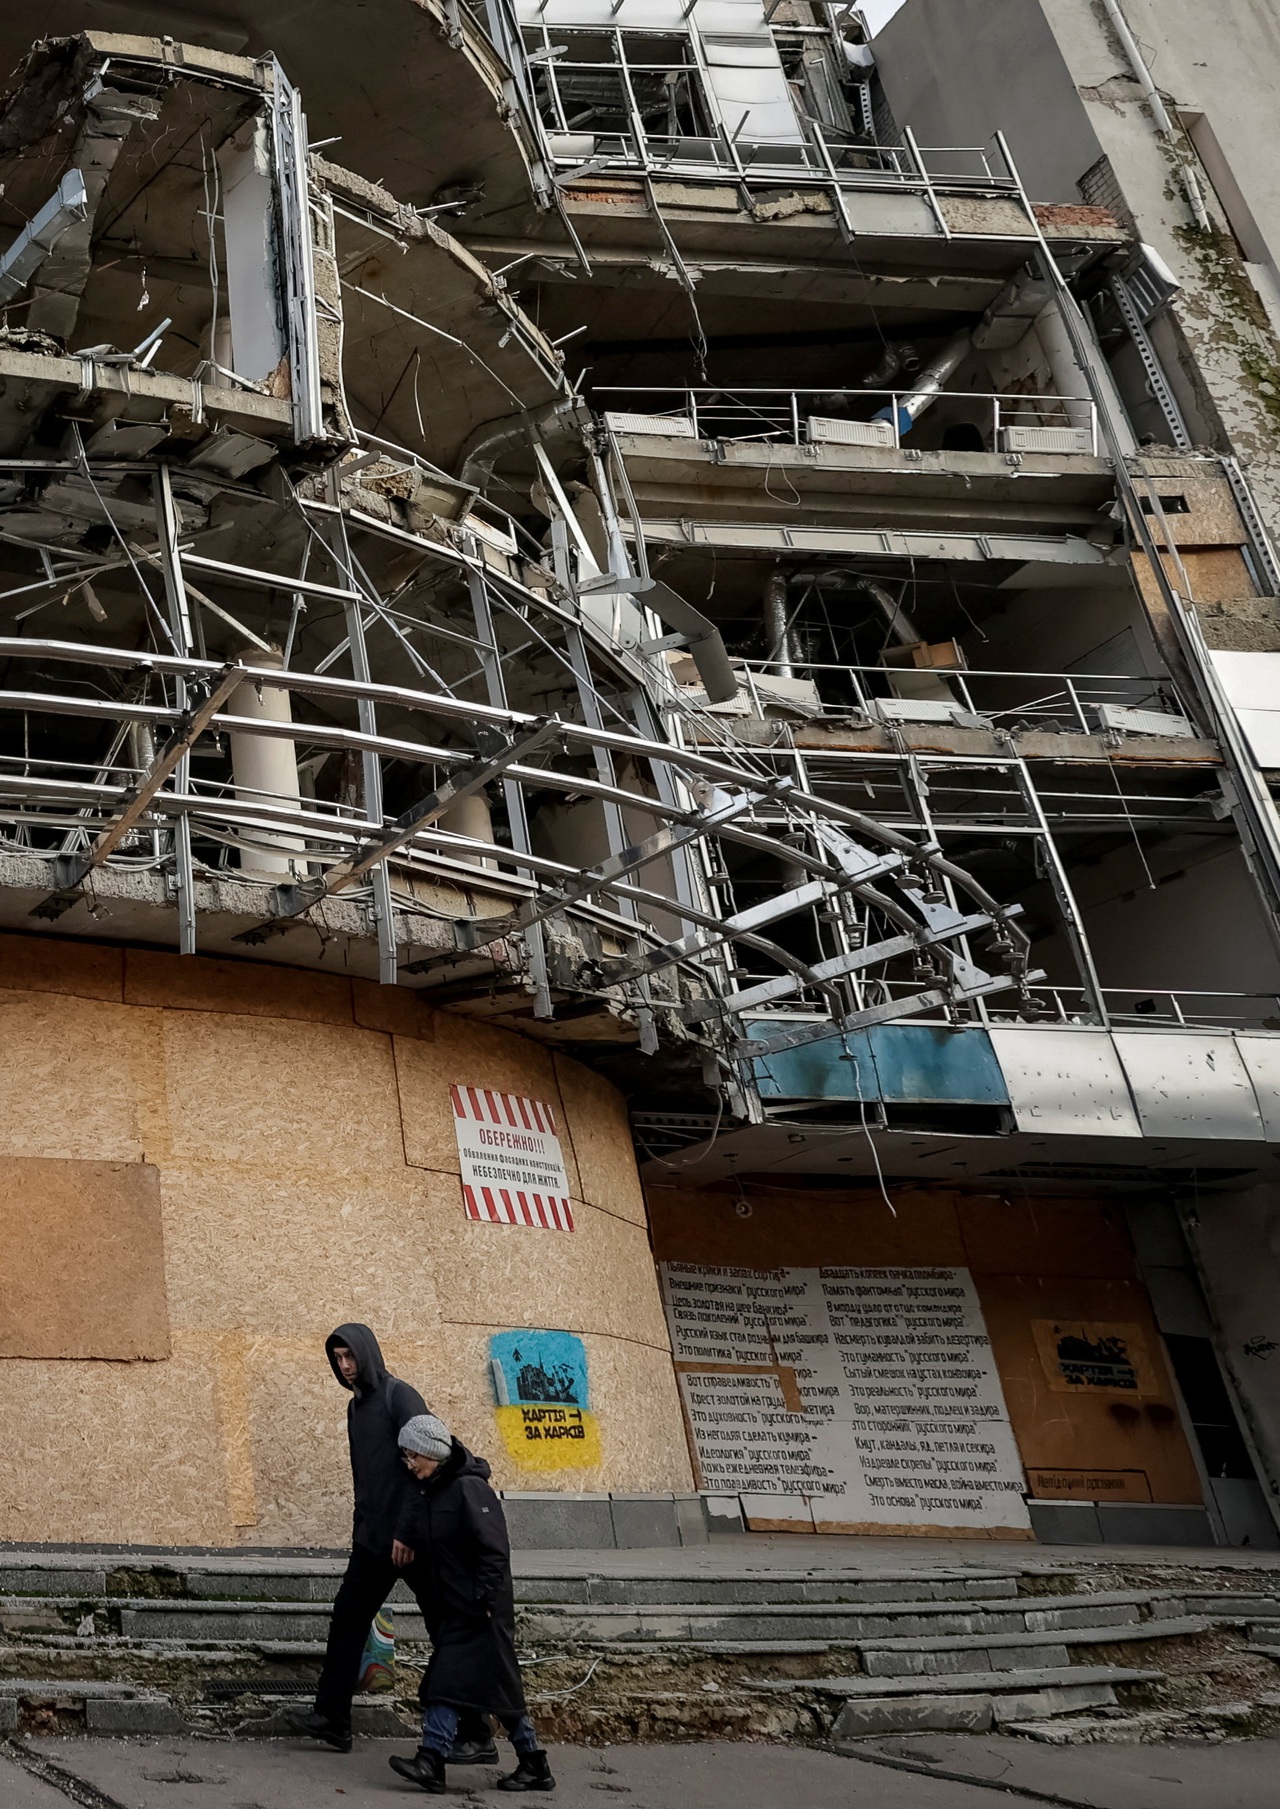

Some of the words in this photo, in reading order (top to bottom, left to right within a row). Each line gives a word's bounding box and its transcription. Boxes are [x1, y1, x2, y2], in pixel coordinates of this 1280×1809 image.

[479, 1128, 545, 1154] ОБЕРЕЖНО!!!
[463, 1148, 498, 1162] Обвалення
[499, 1153, 529, 1167] фасадних
[472, 1164, 521, 1182] НЕБЕЗПЕЧНО
[522, 1171, 537, 1185] ДЛЯ
[537, 1174, 561, 1189] ЖИТТЯ.
[669, 1278, 704, 1291] Внешние
[704, 1282, 742, 1295] признаки
[822, 1284, 854, 1296] Память
[673, 1308, 697, 1320] Связь
[697, 1312, 740, 1324] поколений
[829, 1315, 845, 1327] Вот
[675, 1325, 709, 1340] Русский
[709, 1330, 728, 1341] язык
[729, 1332, 747, 1342] стал
[833, 1332, 876, 1347] Насмерть
[915, 1332, 945, 1345] забить
[678, 1342, 693, 1355] Это
[693, 1346, 732, 1359] политика
[839, 1350, 855, 1362] Это
[855, 1352, 905, 1365] гуманность
[686, 1374, 701, 1387] Вот
[702, 1377, 770, 1389] справедливость
[843, 1366, 872, 1378] Сытый
[873, 1369, 906, 1378] смешок
[906, 1369, 917, 1378] на
[917, 1369, 942, 1382] устах
[690, 1392, 715, 1406] Крест
[716, 1392, 751, 1406] золотой
[751, 1396, 761, 1406] на
[848, 1384, 865, 1396] Это
[865, 1387, 914, 1399] реальность
[521, 1408, 566, 1423] ХАРТІЯ
[690, 1409, 707, 1422] Это
[708, 1411, 758, 1425] духовность
[854, 1402, 874, 1417] Вор,
[524, 1425, 542, 1440] ЗА
[543, 1424, 585, 1440] ХАРКІВ
[694, 1427, 706, 1440] Из
[706, 1430, 742, 1442] негодяя
[742, 1430, 777, 1442] сделать
[867, 1421, 912, 1434] сторонник
[698, 1445, 745, 1459] Идеология
[854, 1436, 880, 1453] Кнут,
[880, 1440, 920, 1452] кандалы,
[934, 1441, 960, 1452] петля
[966, 1442, 996, 1456] секира
[701, 1461, 725, 1473] Ложь
[725, 1463, 780, 1474] ежедневная
[859, 1455, 900, 1470] Издревле
[900, 1459, 932, 1471] скрепы
[703, 1476, 720, 1489] Это
[864, 1474, 894, 1489] Смерть
[894, 1477, 923, 1489] вместо
[923, 1478, 951, 1490] масла,
[950, 1477, 974, 1490] война
[974, 1480, 1003, 1491] вместо
[1003, 1481, 1024, 1494] мира
[868, 1493, 885, 1506] Это
[886, 1496, 916, 1507] основа
